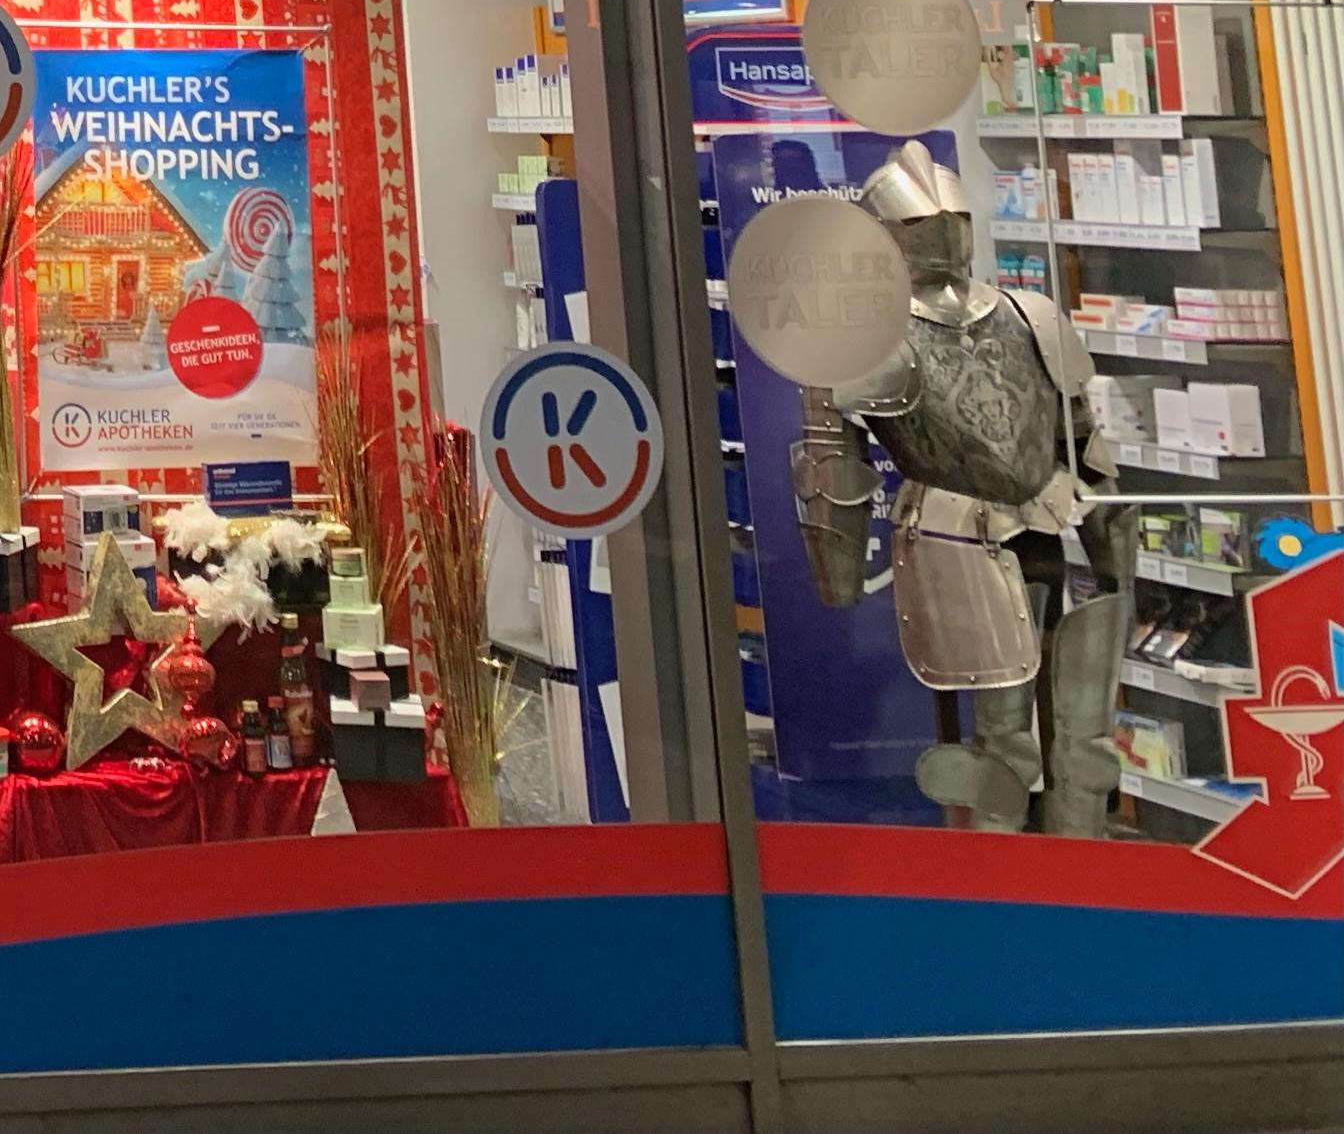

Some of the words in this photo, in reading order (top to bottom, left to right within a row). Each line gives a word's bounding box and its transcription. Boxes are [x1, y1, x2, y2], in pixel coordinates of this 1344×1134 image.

[819, 3, 966, 34] KUCHLER
[819, 37, 965, 80] TALER
[65, 75, 230, 104] KUCHLER'S
[49, 110, 294, 143] WEIHNACHTS-
[83, 148, 260, 181] SHOPPING
[752, 186, 781, 204] Wir
[745, 251, 896, 284] KUCHLER
[746, 288, 897, 332] TALER
[169, 333, 260, 354] GESCHENKIDEEN,
[181, 353, 200, 367] DIE
[201, 352, 224, 365] GUT
[226, 348, 254, 363] TUN.
[97, 409, 171, 424] KUCHLER
[97, 424, 193, 440] APOTHEKEN
